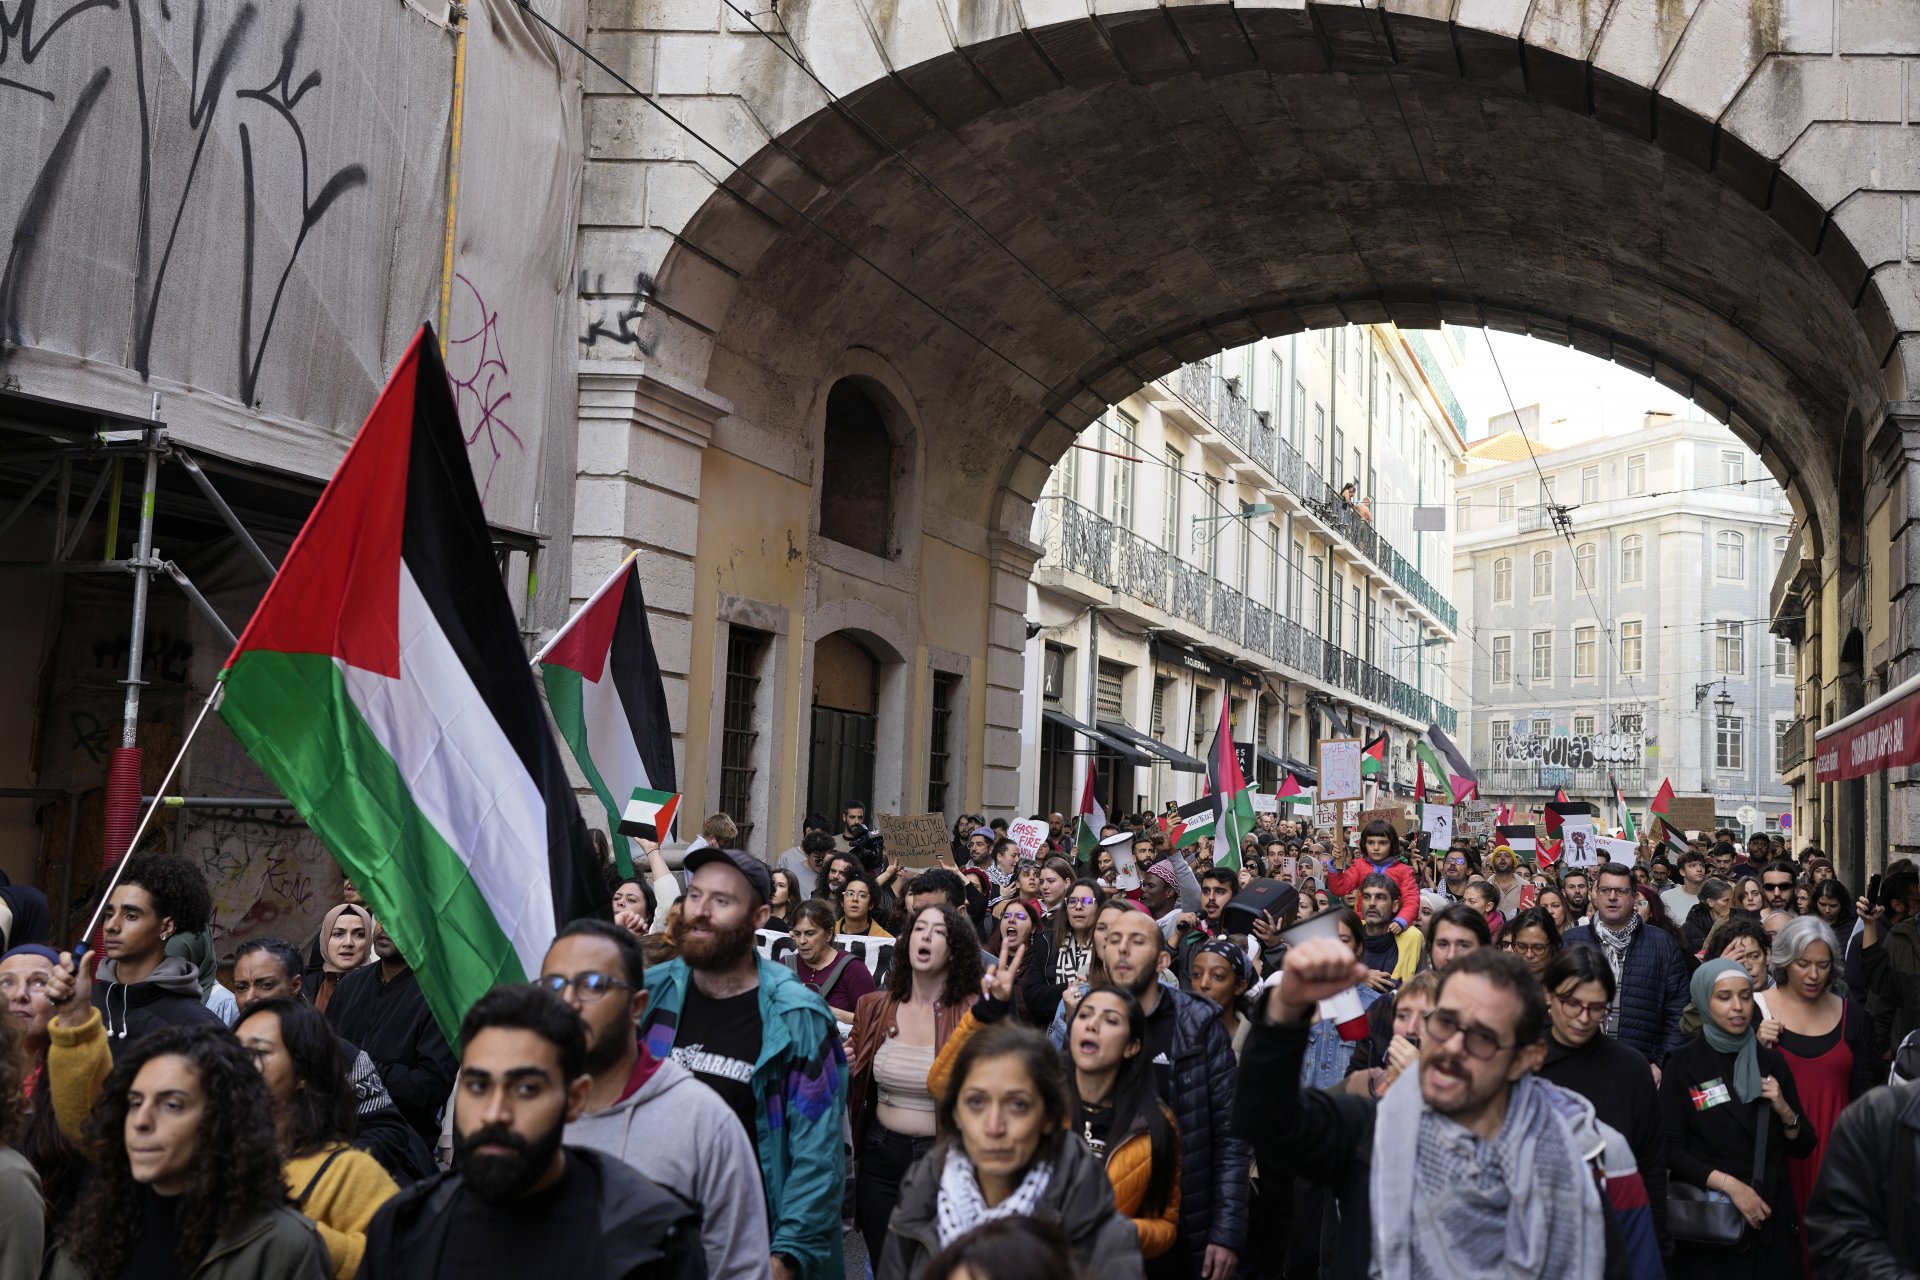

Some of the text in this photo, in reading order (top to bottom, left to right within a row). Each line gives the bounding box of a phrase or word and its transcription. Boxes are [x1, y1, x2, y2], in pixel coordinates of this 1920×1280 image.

[1012, 822, 1039, 836] CEASE
[1018, 835, 1042, 849] FIRE
[693, 1052, 755, 1083] GARAGE
